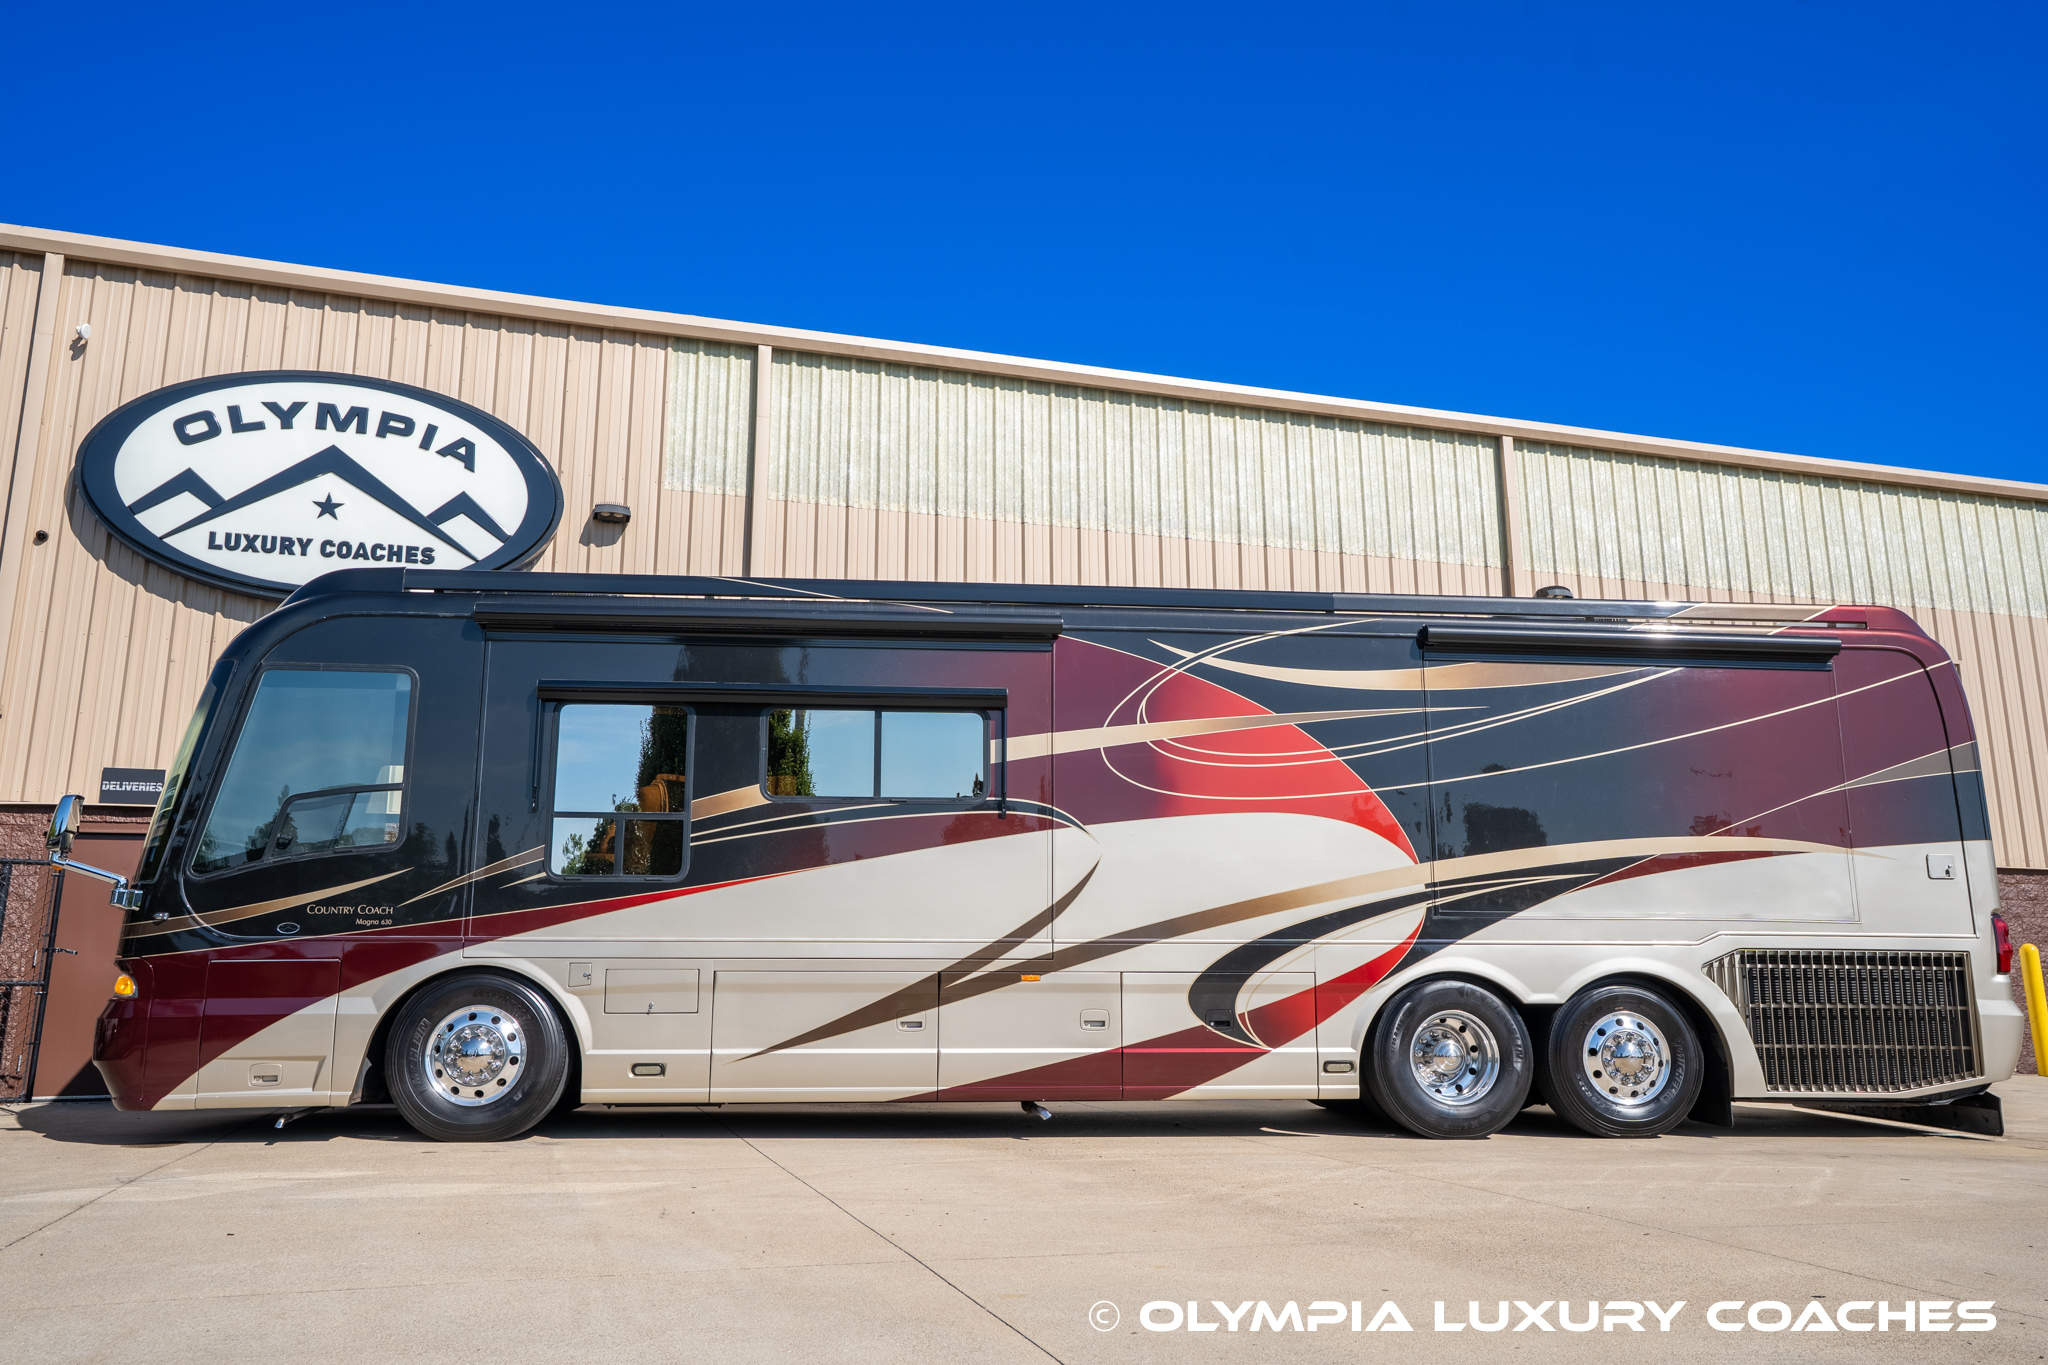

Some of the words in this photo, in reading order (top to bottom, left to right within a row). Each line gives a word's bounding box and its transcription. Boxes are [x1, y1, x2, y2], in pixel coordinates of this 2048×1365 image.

[173, 401, 476, 474] OLYMPIA
[208, 531, 313, 557] LUXURY
[320, 538, 436, 565] COACHES
[101, 780, 163, 793] DELIVERIES
[306, 904, 355, 915] COUNTRY
[357, 904, 394, 915] COACH
